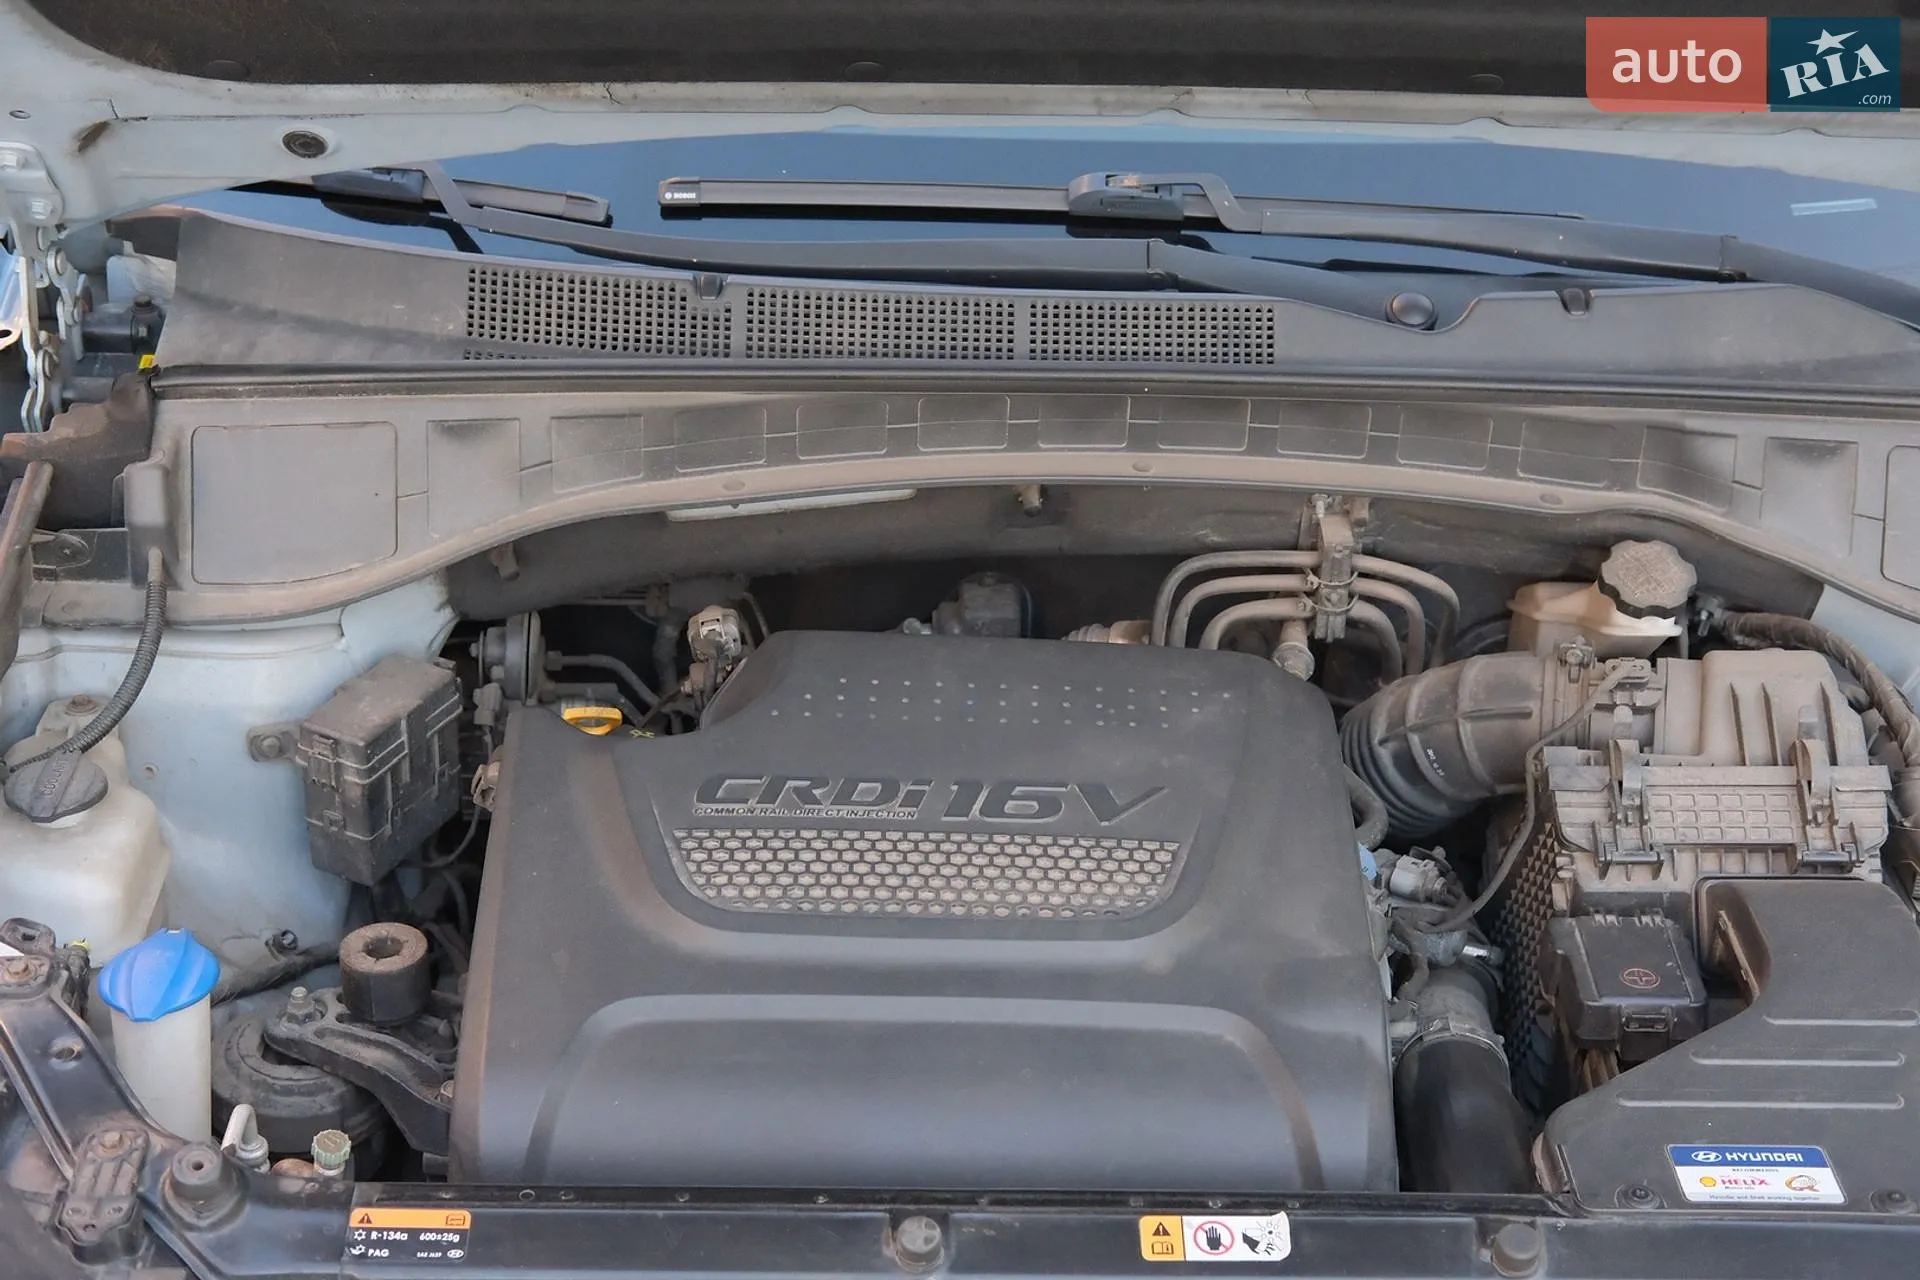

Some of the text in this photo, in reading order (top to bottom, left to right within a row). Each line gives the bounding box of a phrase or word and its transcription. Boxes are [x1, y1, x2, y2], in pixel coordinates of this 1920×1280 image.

[695, 775, 1169, 826] CRDi 16V
[694, 807, 918, 820] COMMON RAIL DIRECT INJECTION
[1725, 1152, 1803, 1162] HYUNDAI
[370, 1231, 408, 1241] R-134a
[367, 1249, 390, 1258] PAG
